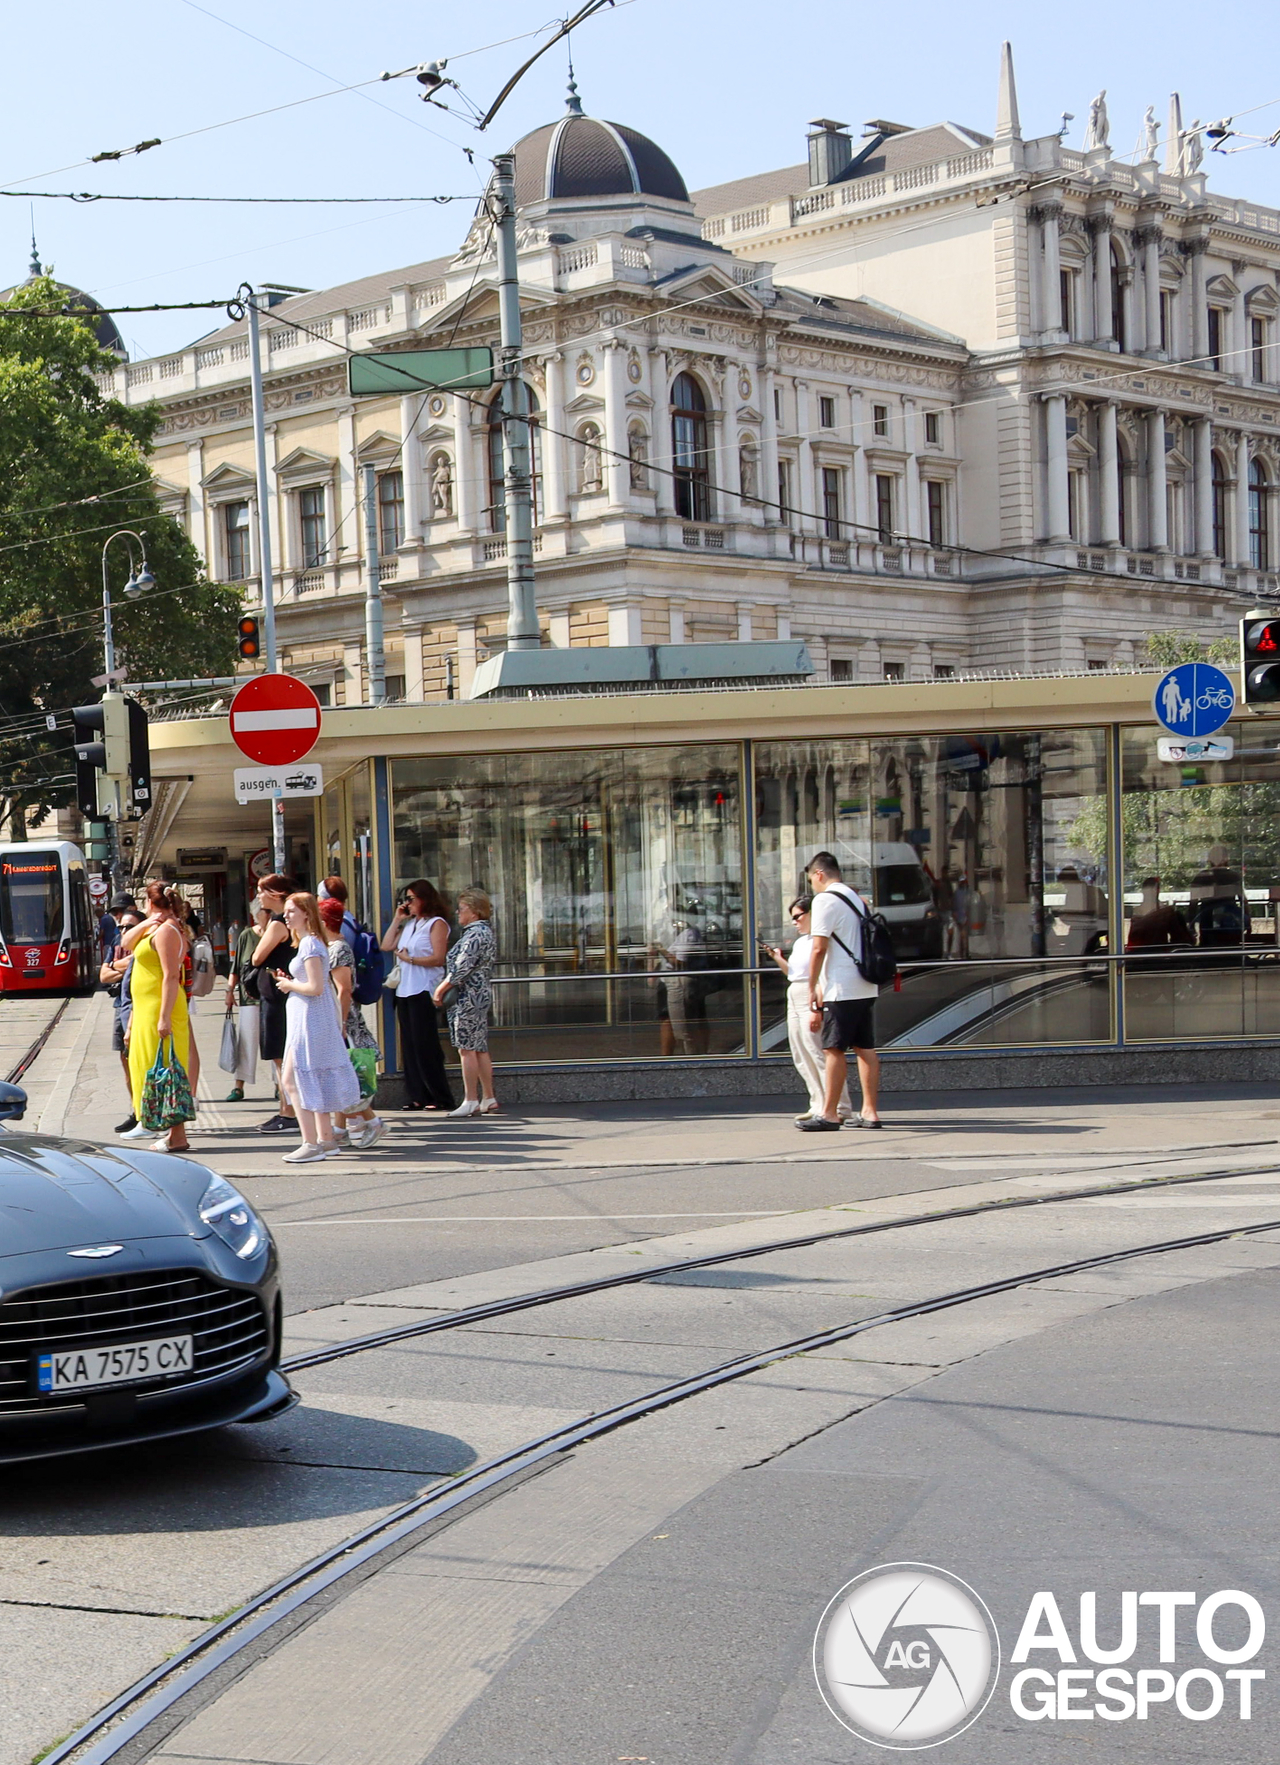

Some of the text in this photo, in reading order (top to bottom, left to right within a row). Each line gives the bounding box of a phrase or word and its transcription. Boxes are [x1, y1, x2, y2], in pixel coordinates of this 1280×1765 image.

[240, 779, 281, 791] ausgen.
[26, 958, 40, 966] 327
[55, 1340, 188, 1384] KA 7575 CX
[40, 1377, 52, 1386] UA
